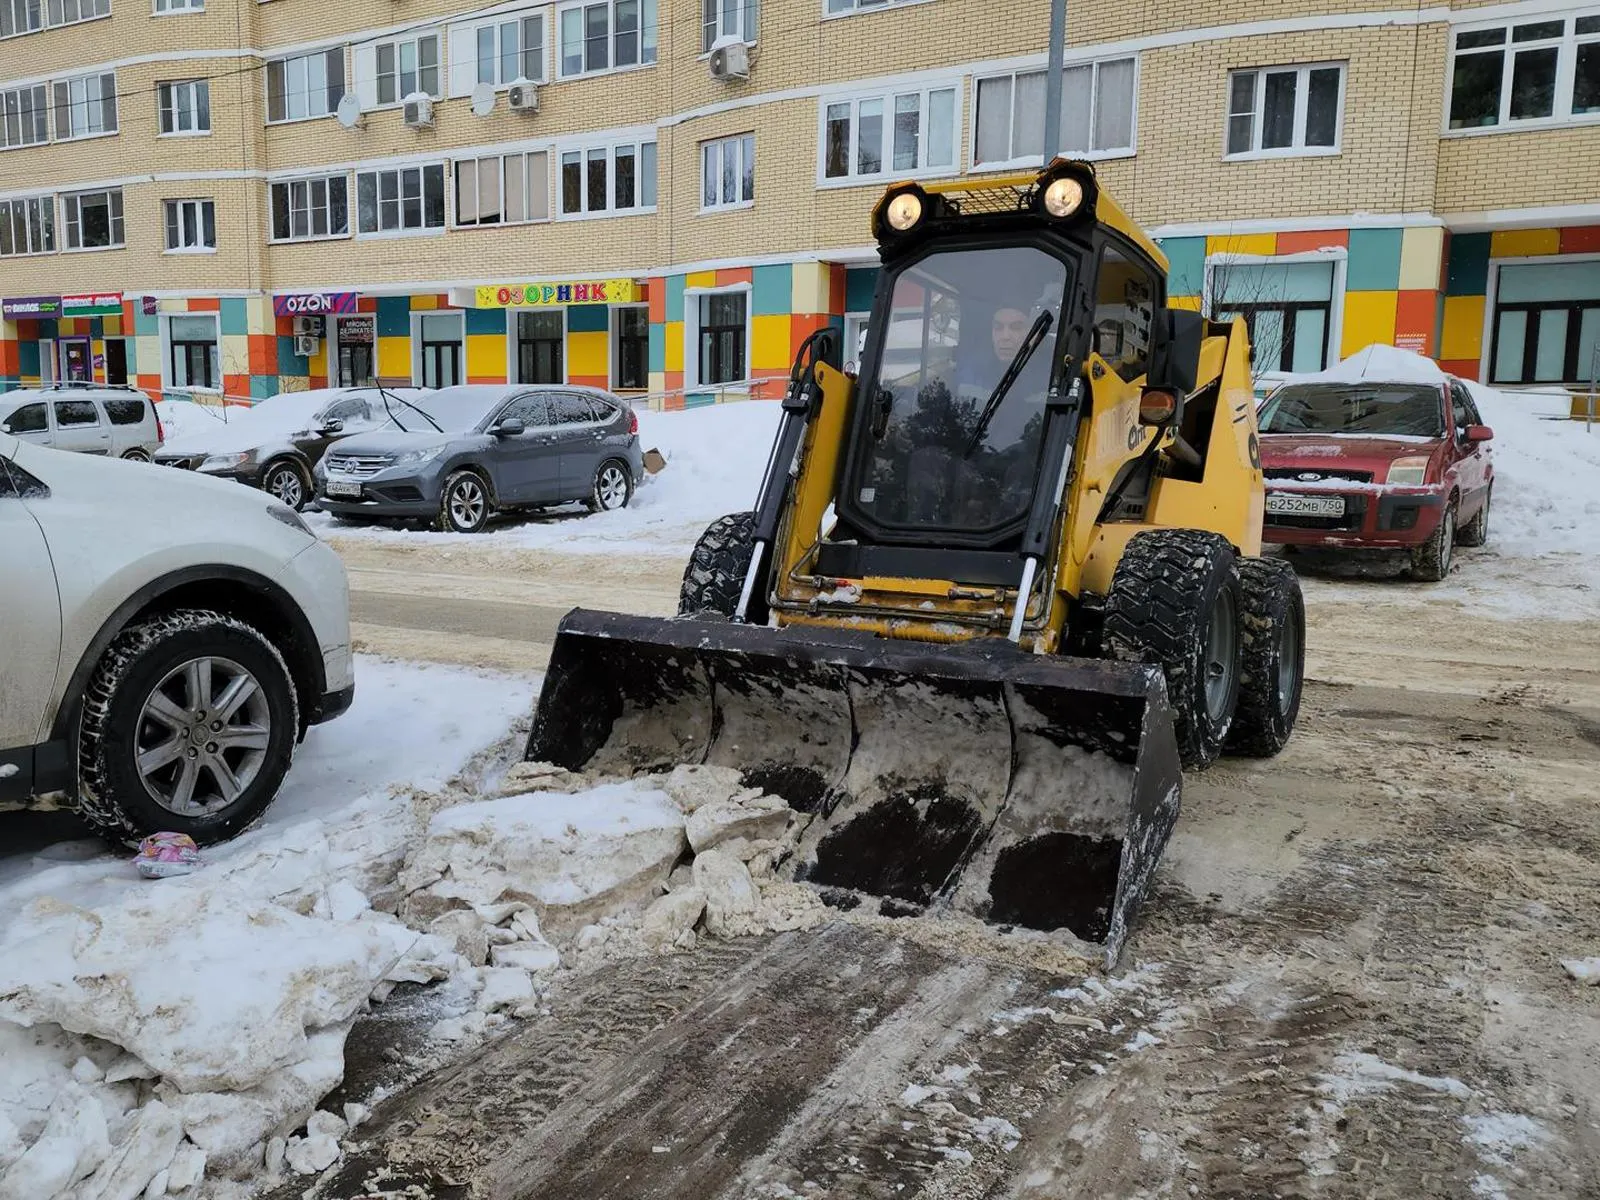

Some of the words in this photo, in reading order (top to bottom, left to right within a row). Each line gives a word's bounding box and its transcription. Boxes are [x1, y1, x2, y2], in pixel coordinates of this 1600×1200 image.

[497, 283, 608, 304] ОЗОРНИК
[287, 294, 332, 311] OZON
[1322, 500, 1342, 510] 750
